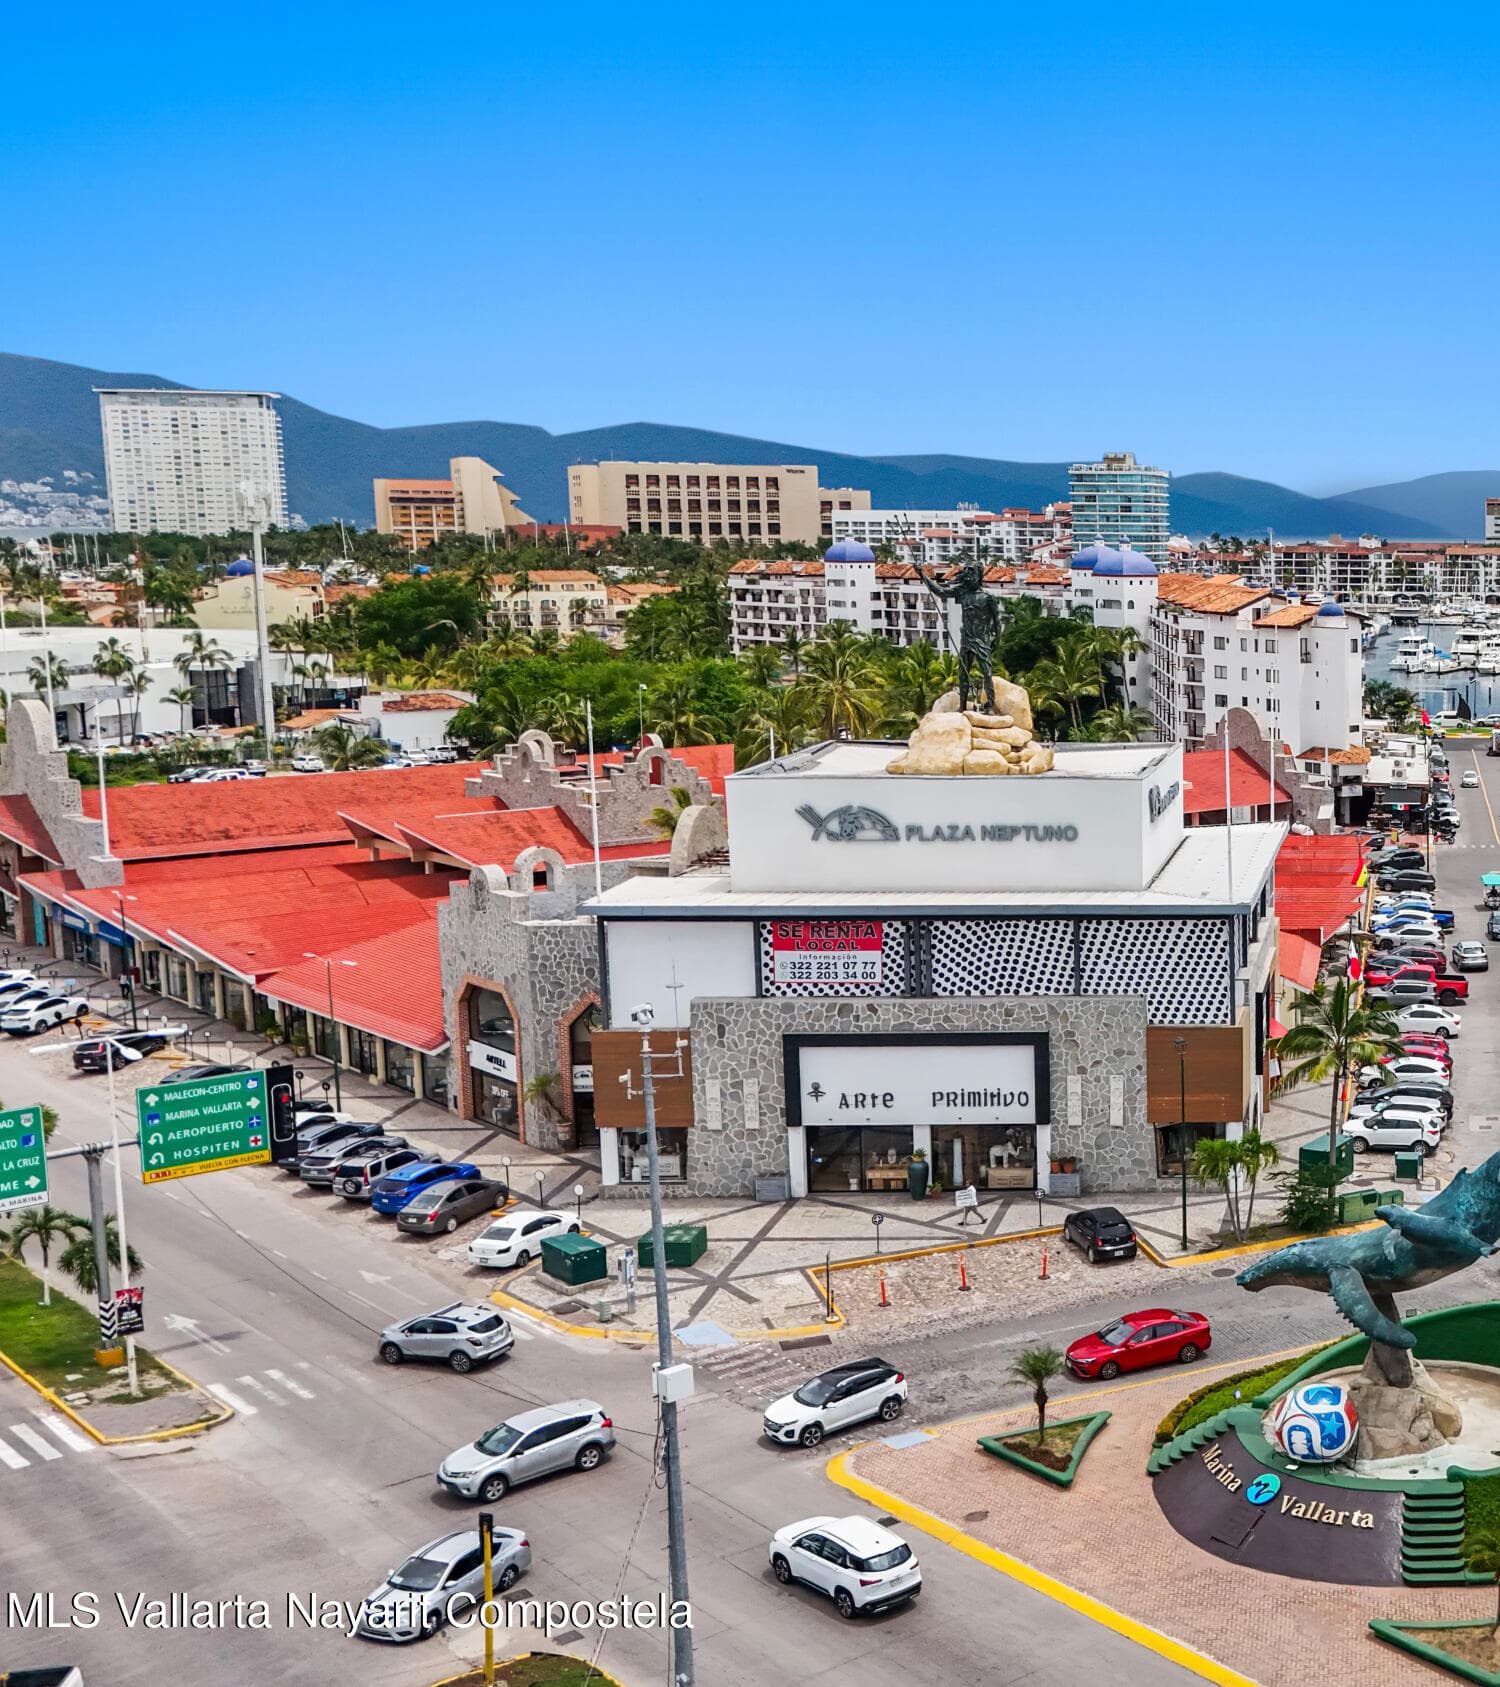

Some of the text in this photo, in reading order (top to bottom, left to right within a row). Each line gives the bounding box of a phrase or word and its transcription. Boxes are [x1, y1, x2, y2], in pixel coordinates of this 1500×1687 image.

[905, 824, 1079, 842] PLAZA NEPTUNO
[778, 923, 877, 939] SE RENTA
[794, 940, 861, 951] LOCAL
[789, 961, 876, 970] 322 221 07 77
[789, 971, 876, 980] 322 203 34 00
[164, 1081, 242, 1102] MALECON-CENTRO
[165, 1101, 243, 1121] MARINA VALLARTA
[167, 1120, 244, 1141] AEROPUERTO
[173, 1140, 240, 1159] HOSPITEN
[3, 1156, 40, 1171] LA CRUZ
[9, 1196, 43, 1207] MARINA
[1202, 1443, 1374, 1529] Marina Vallarta
